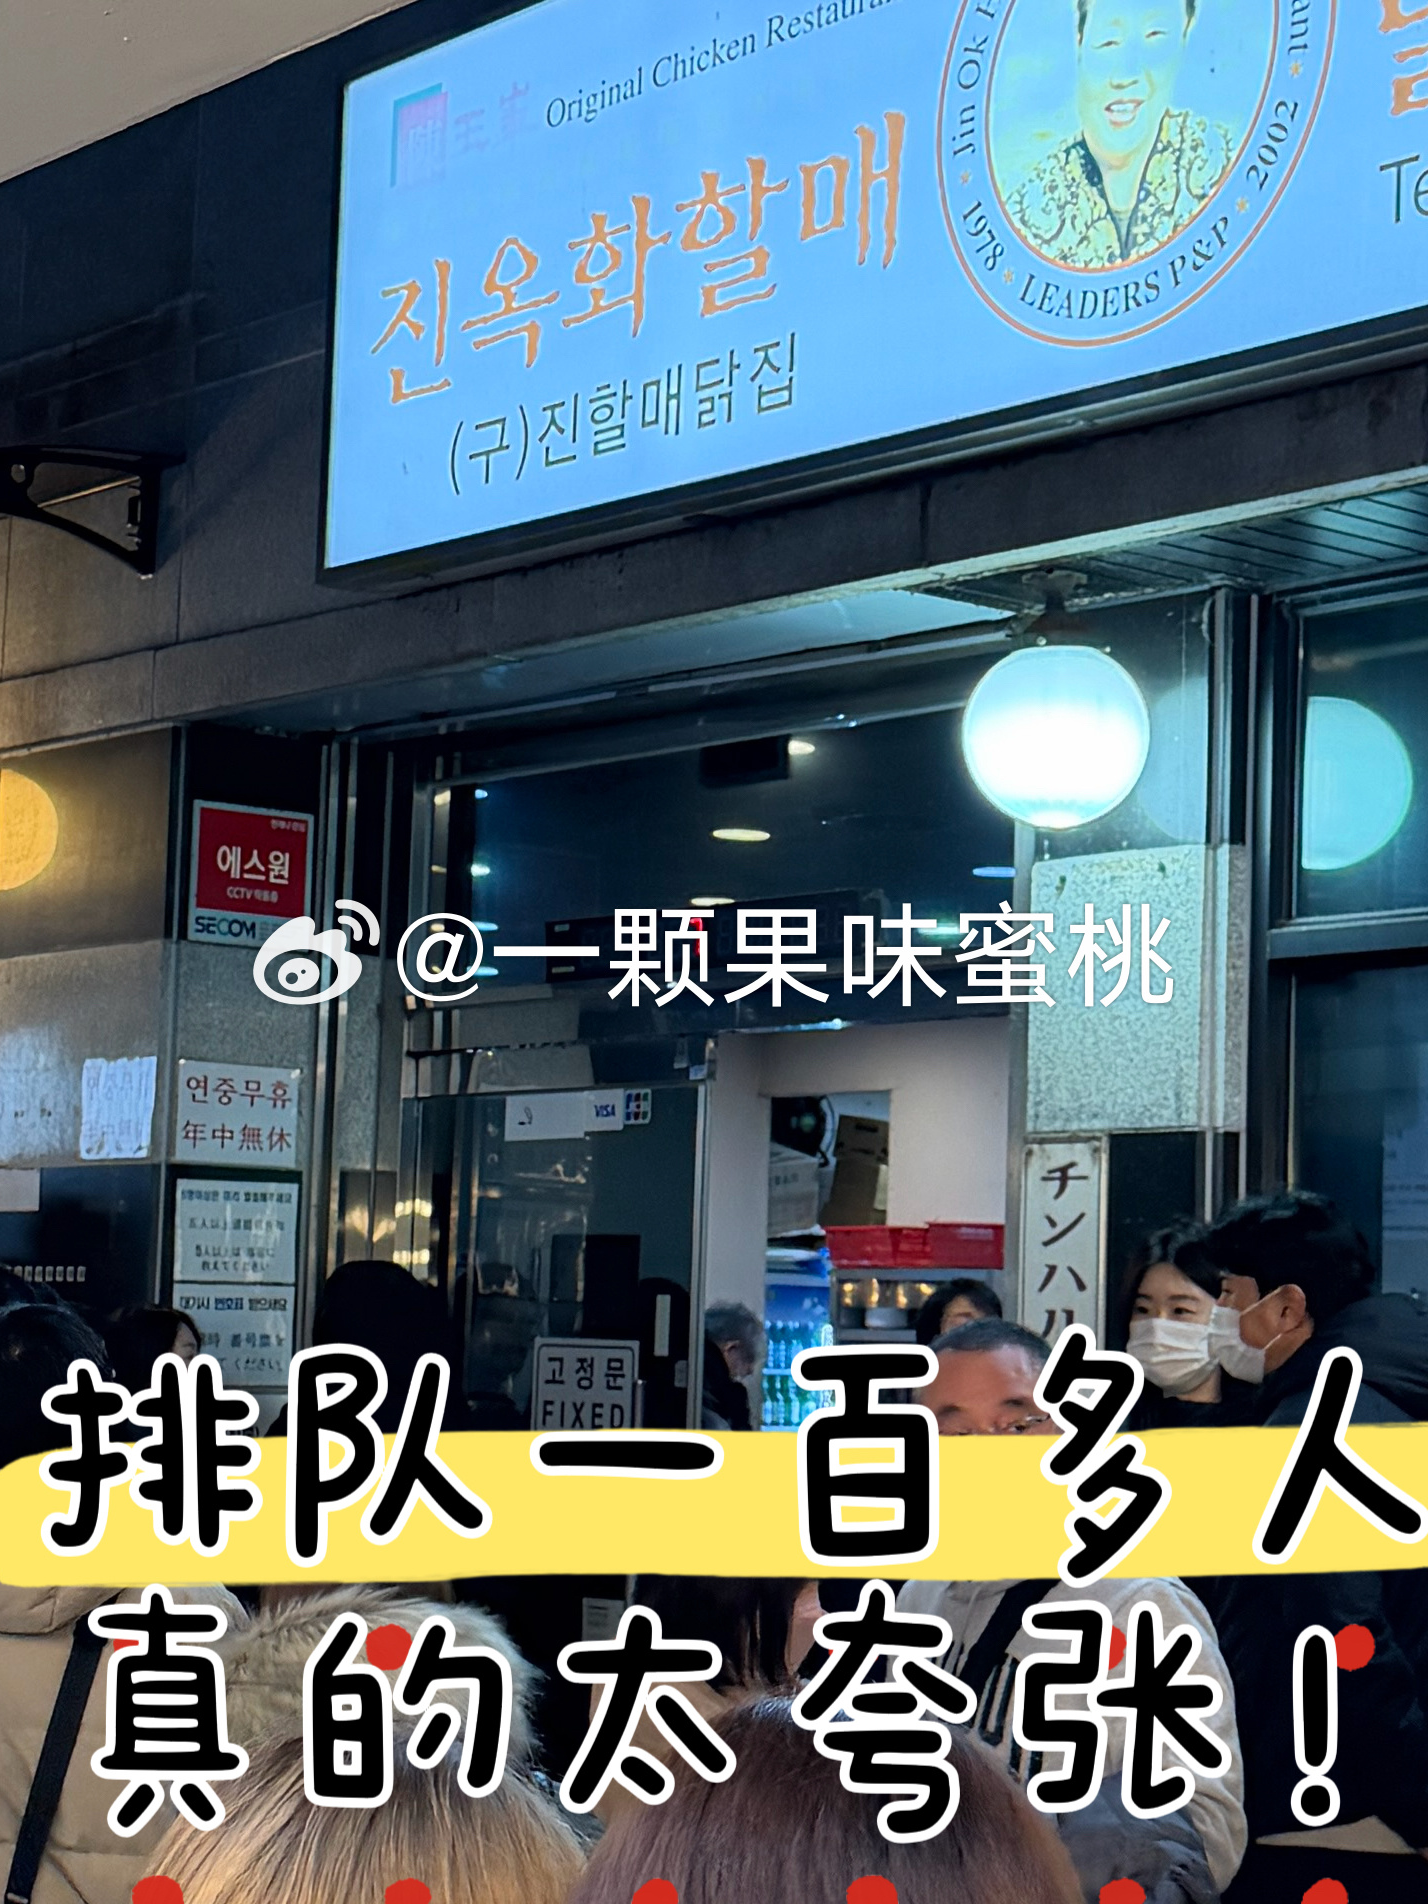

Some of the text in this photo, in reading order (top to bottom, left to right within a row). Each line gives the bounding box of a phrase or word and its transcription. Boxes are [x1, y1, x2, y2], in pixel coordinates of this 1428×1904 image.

[546, 65, 644, 129] Original
[651, 30, 757, 89] Chicken
[957, 34, 988, 90] Ok
[952, 104, 976, 159] Jin
[1246, 98, 1300, 191] 2002
[370, 111, 907, 404] 진옥화할매
[961, 199, 1008, 272] 1978
[1018, 215, 1231, 321] LEADERS P&P
[449, 331, 799, 496] (구)진할매닭집
[216, 844, 290, 885] 에스원
[226, 886, 253, 900] CCTV
[195, 915, 257, 940] SECOM
[185, 1074, 293, 1110] 연중무휴
[594, 1104, 616, 1118] VISA
[180, 1120, 293, 1152] 年中無休
[544, 1356, 626, 1391] 고정문
[541, 1399, 625, 1430] FIXED
